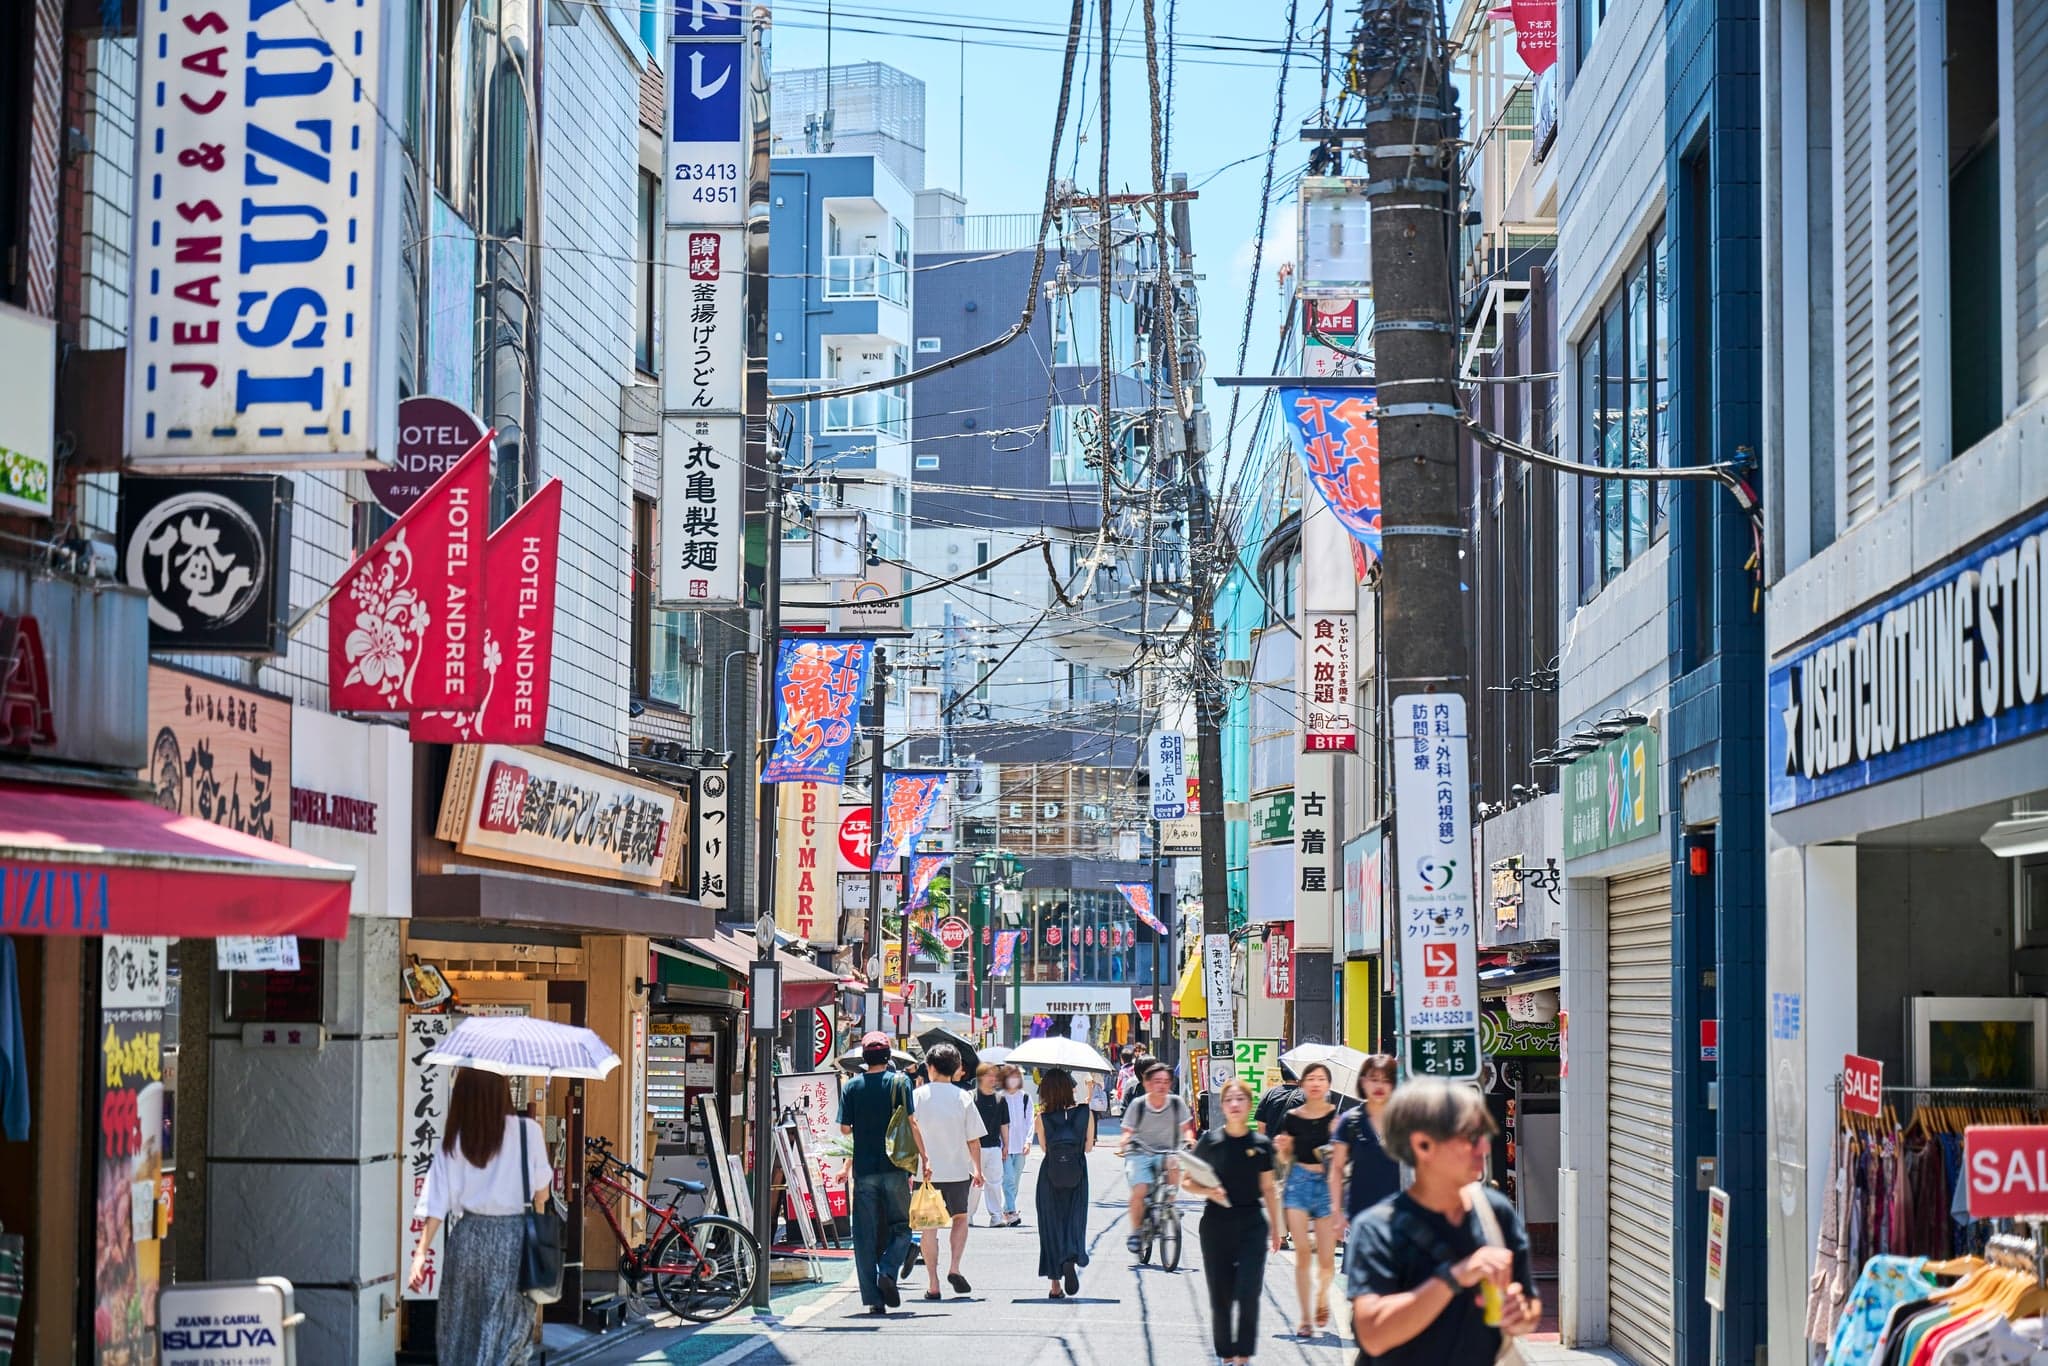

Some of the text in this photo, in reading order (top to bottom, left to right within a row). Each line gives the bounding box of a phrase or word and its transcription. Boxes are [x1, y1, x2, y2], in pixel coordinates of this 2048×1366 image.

[1528, 21, 1552, 29] 下北沢
[692, 163, 737, 181] 3413
[171, 12, 229, 388] JEANS & CAS
[692, 187, 737, 204] 4951
[690, 283, 719, 407] 釜揚げうどん
[862, 352, 884, 361] WINE
[401, 426, 469, 446] OTEL
[681, 441, 721, 572] 丸亀製麺
[444, 487, 469, 696] HOTEL ANDREE
[514, 536, 540, 730] HOTEL ANDREE
[1313, 618, 1335, 704] 食べ放題
[828, 644, 865, 718] 下北沢
[1801, 637, 1853, 780] USED
[1854, 568, 1980, 762] CLOTHING
[1315, 736, 1346, 749] B1F
[1412, 703, 1430, 771] 訪問診療
[1160, 735, 1176, 802] お粥と点心
[847, 820, 871, 832] ステー
[1301, 791, 1327, 892] 古着屋
[701, 810, 726, 898] つけ麺
[847, 884, 870, 892] ステー
[1412, 906, 1465, 921] シモキタ
[1407, 923, 1470, 938] クリニック
[1427, 980, 1457, 993] 手前
[1046, 1002, 1092, 1012] THRIFTY
[1421, 995, 1461, 1008] 右曲る
[411, 1019, 448, 1035] 丸亀
[1235, 1043, 1268, 1063] 2F
[1421, 1040, 1467, 1055] 北沢
[1425, 1058, 1465, 1073] 2-15
[1844, 1069, 1879, 1104] SALE
[175, 1315, 212, 1327] JEANS
[222, 1314, 261, 1326] CASUAL
[162, 1328, 276, 1351] ISUZUYA
